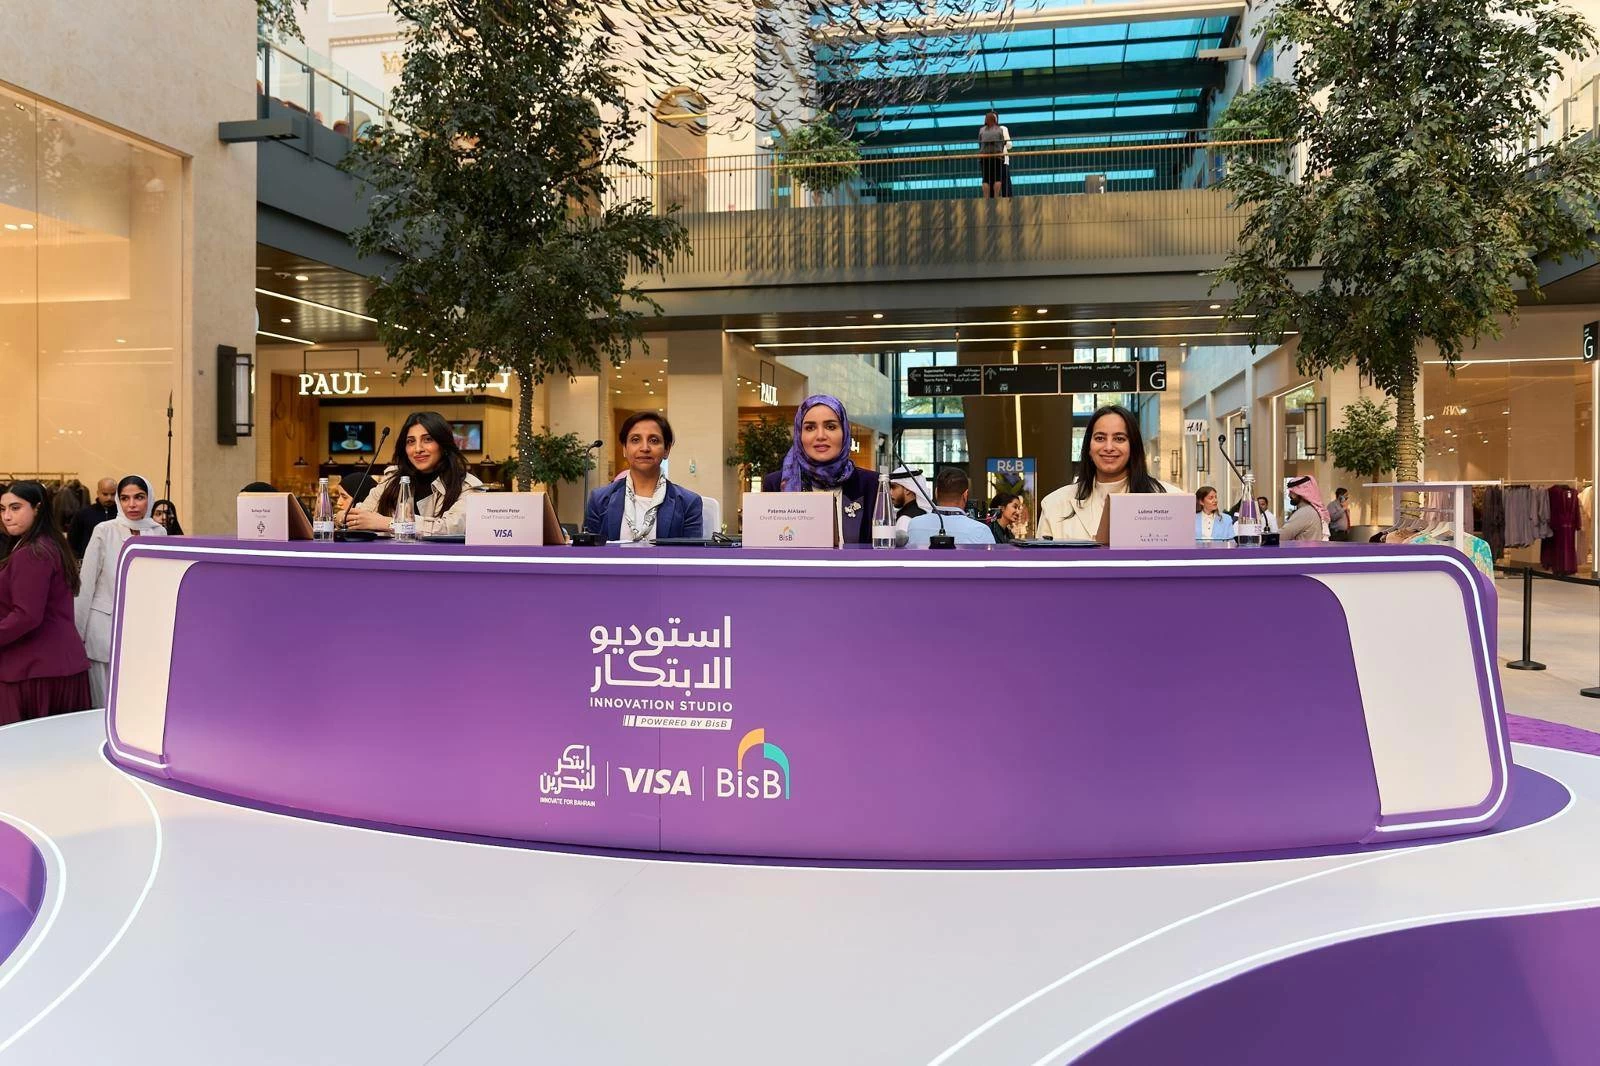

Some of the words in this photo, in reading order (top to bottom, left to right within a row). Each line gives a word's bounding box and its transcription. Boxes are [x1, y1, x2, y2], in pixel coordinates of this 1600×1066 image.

[1584, 336, 1594, 359] G
[299, 372, 369, 395] PAUL
[1150, 371, 1165, 389] G
[760, 382, 779, 406] PAUL
[997, 460, 1024, 472] R&B
[493, 529, 513, 538] VISA
[589, 615, 732, 655] استوديو
[590, 650, 732, 697] الابتكار
[589, 697, 675, 711] INNOVATION
[679, 701, 733, 712] STUDIO
[640, 717, 687, 727] POWERED
[690, 719, 703, 727] BY
[705, 719, 728, 728] BisB
[553, 744, 590, 776] ابتكر
[618, 767, 692, 796] VISA
[716, 768, 782, 800] BisB
[573, 799, 596, 807] BAHRAIN
